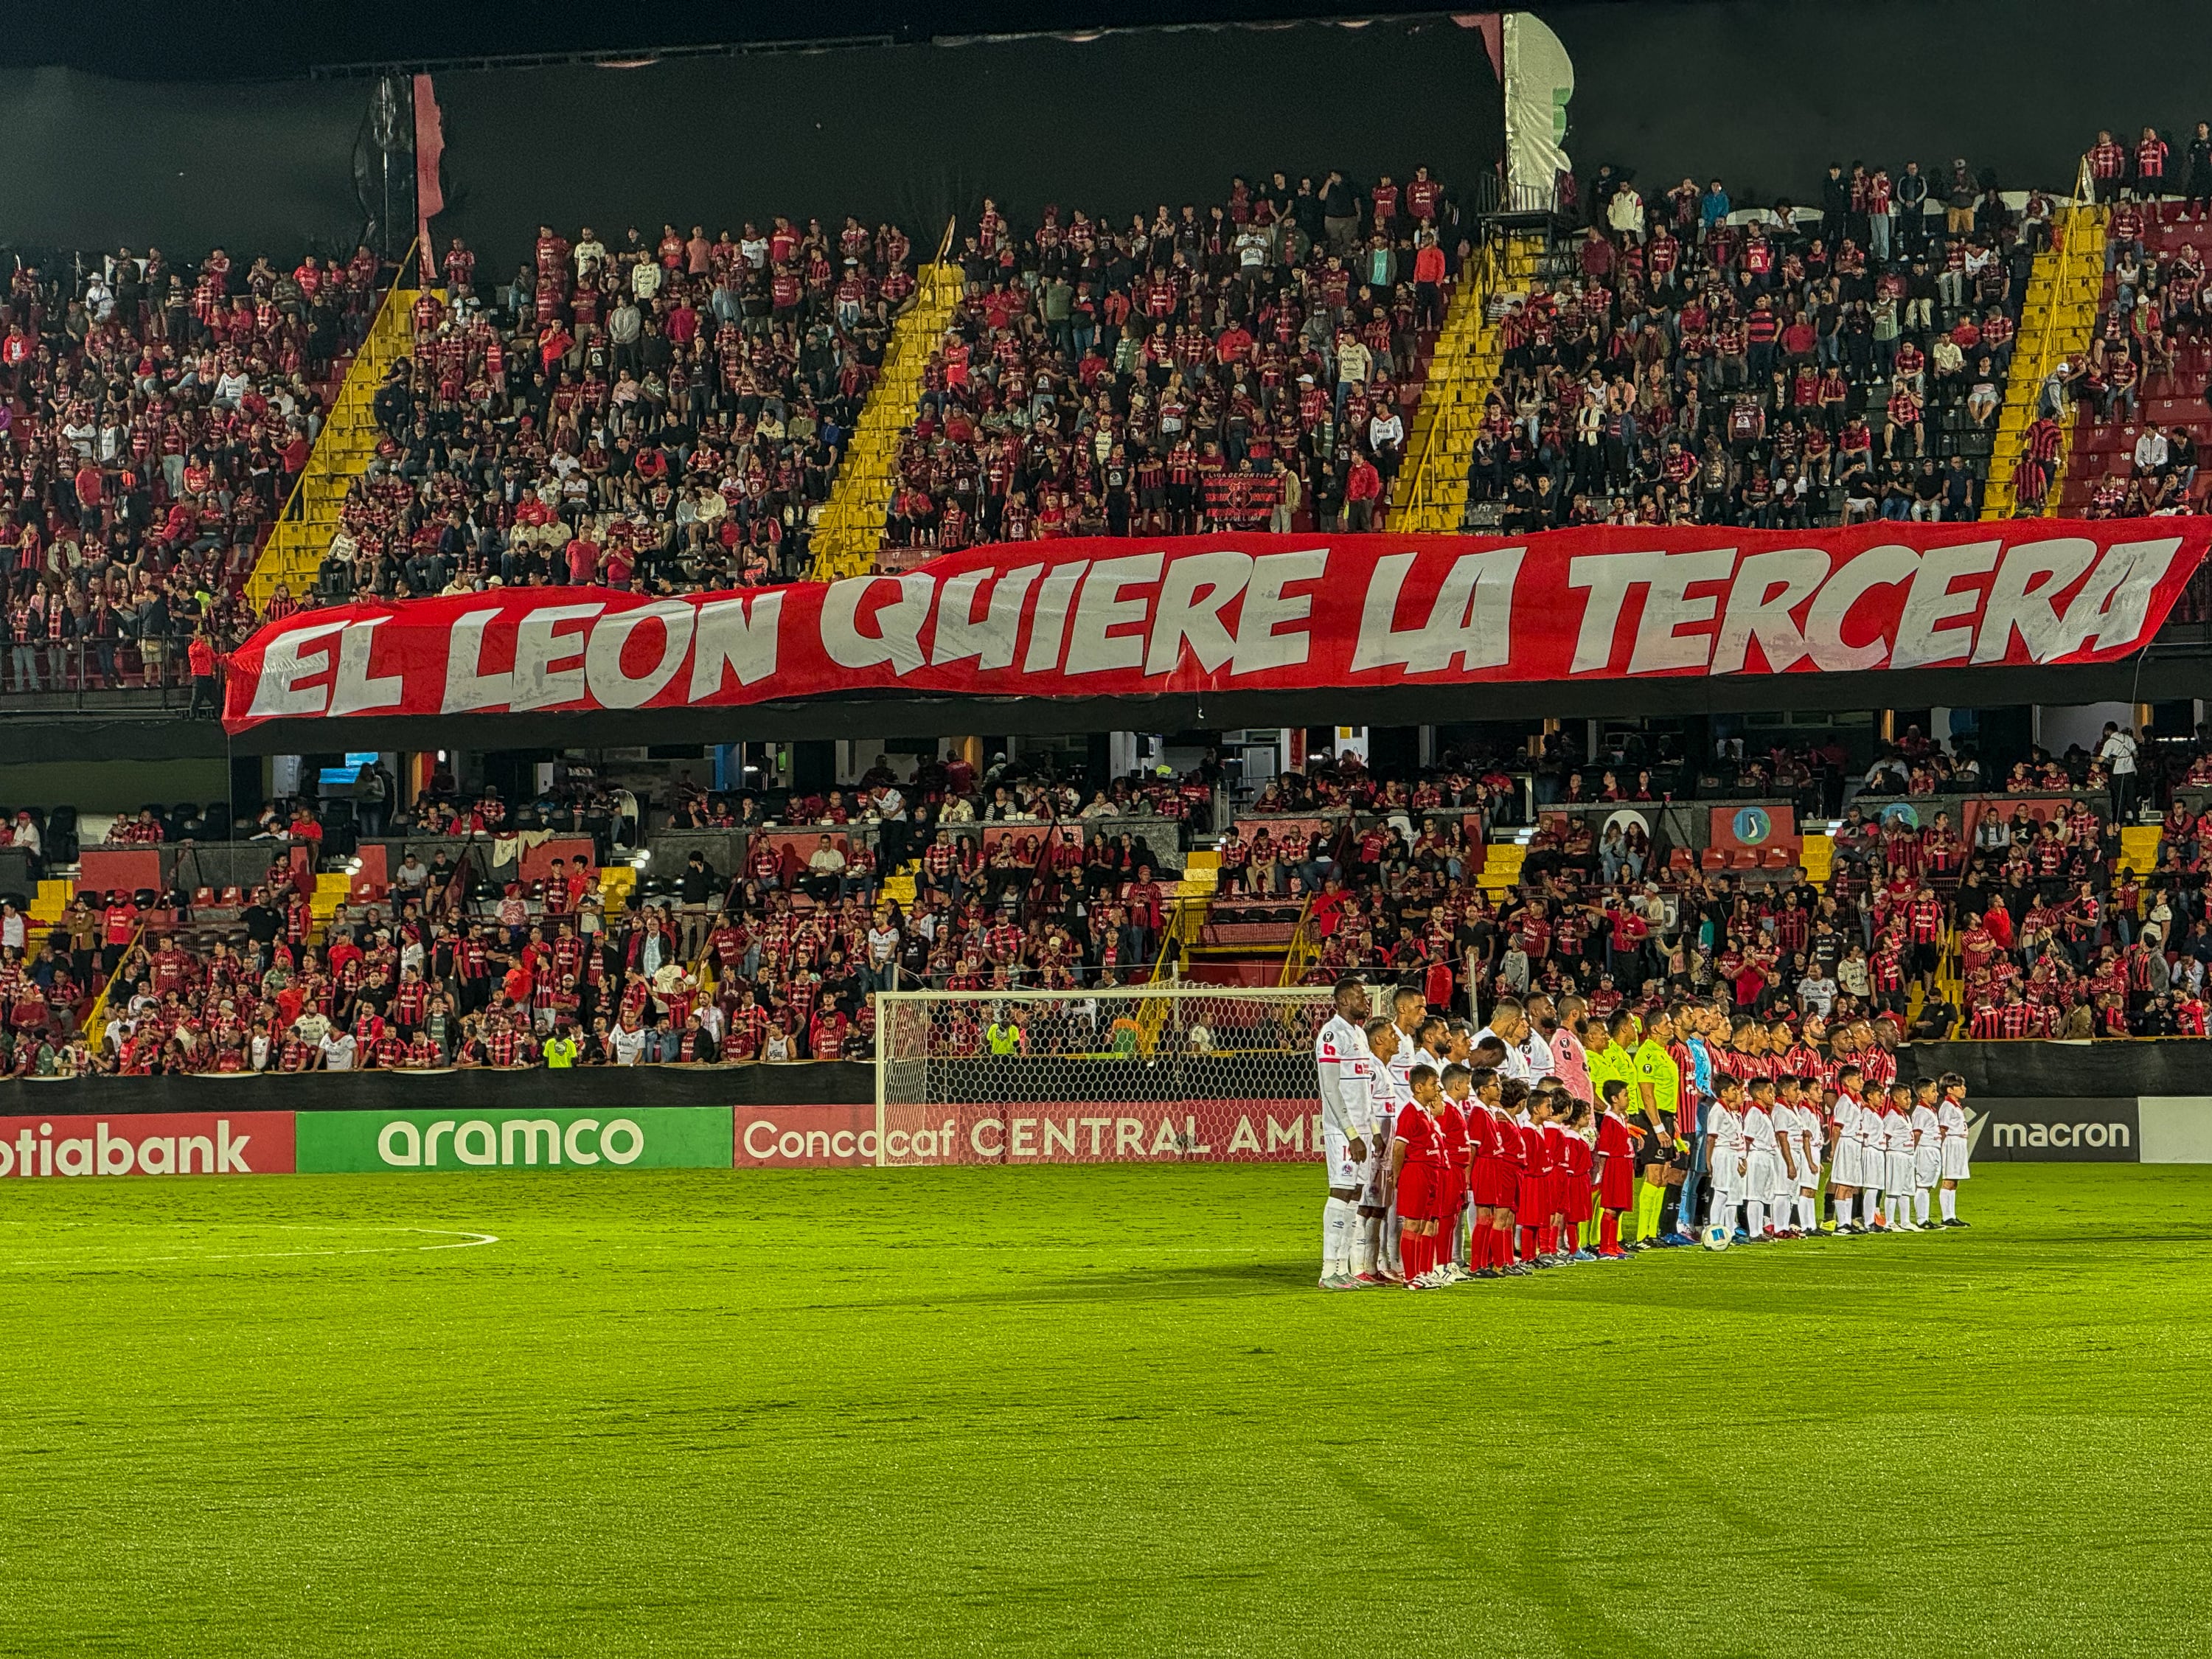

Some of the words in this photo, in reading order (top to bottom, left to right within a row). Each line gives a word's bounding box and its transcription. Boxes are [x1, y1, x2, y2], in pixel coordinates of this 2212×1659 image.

[247, 615, 403, 717] EL
[442, 591, 786, 714] LEON
[820, 548, 1331, 676] QUIERE
[1350, 547, 1528, 674] LA
[1568, 537, 2183, 675] TERCERA
[378, 1119, 644, 1166] aramco
[744, 1119, 955, 1158] Concacaf
[970, 1116, 1211, 1156] CENTRAL
[1993, 1122, 2130, 1147] macron
